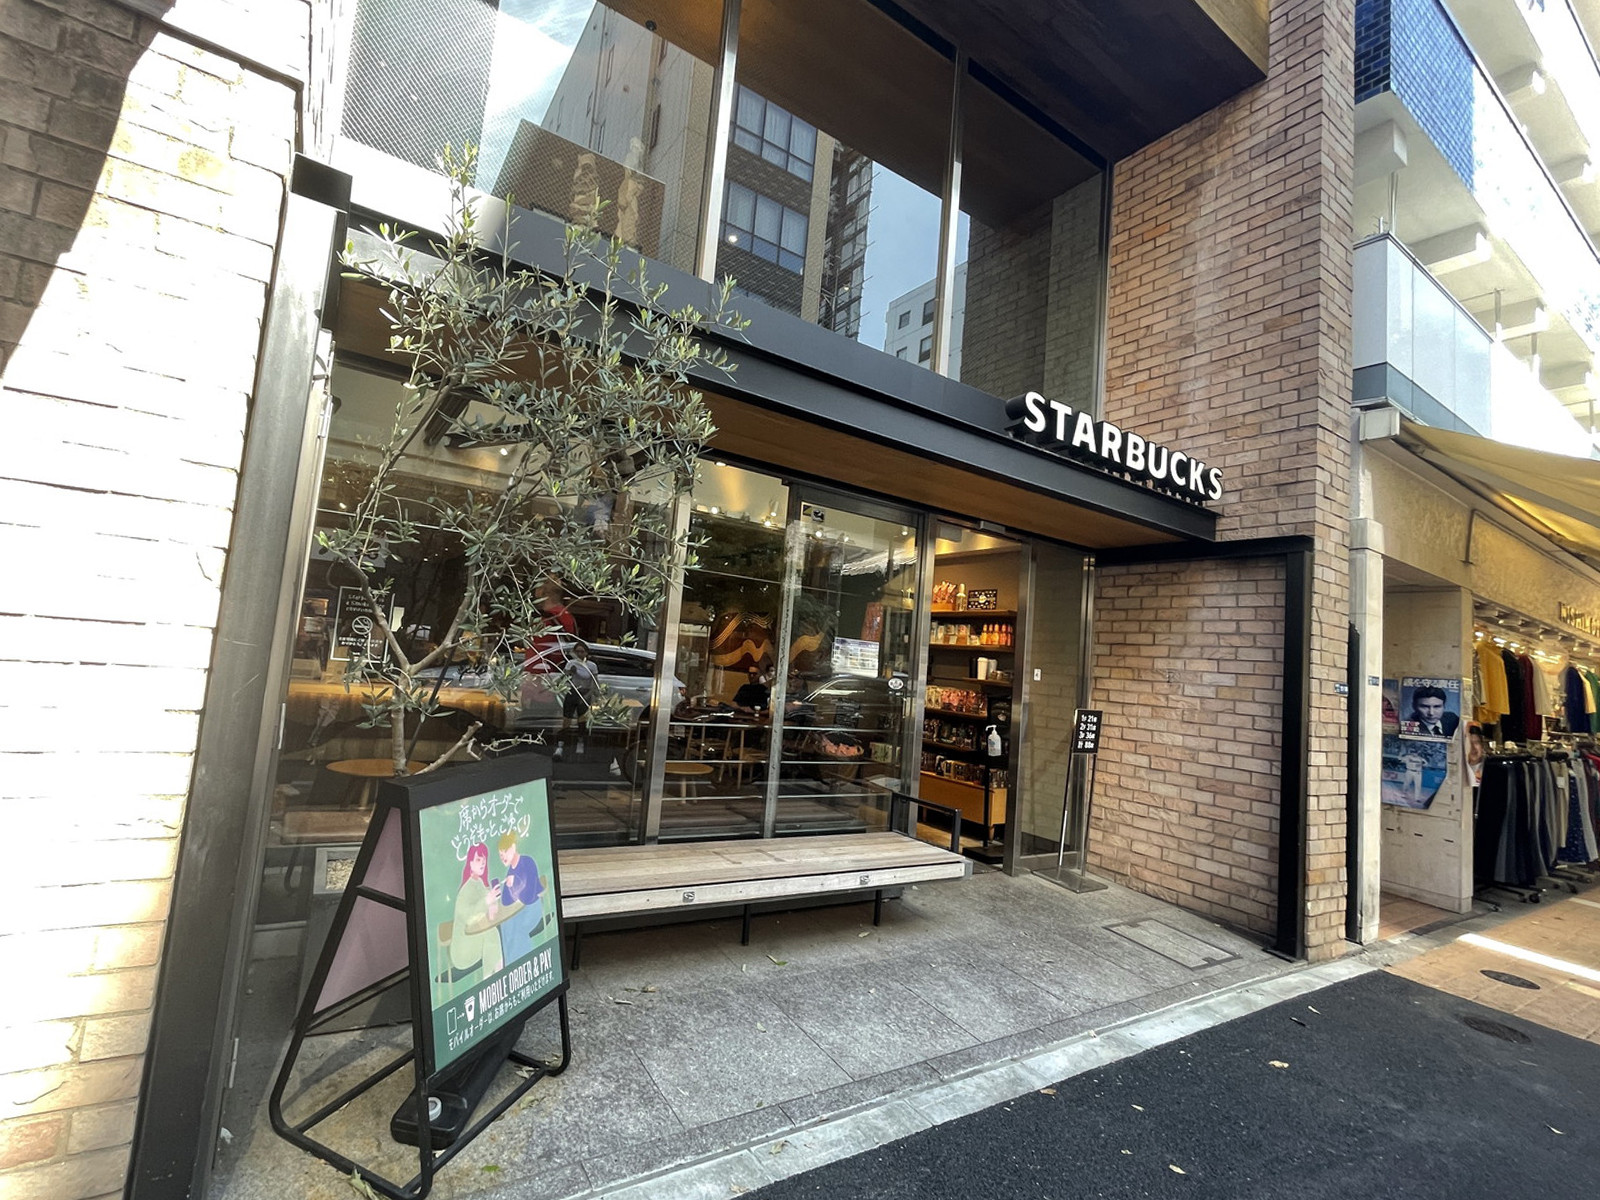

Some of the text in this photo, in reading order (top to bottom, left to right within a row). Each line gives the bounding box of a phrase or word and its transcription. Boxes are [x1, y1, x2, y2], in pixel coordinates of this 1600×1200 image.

[1023, 391, 1224, 500] STARBUCKS
[458, 792, 524, 833] 席からオーダーで
[479, 948, 553, 1014] MOBILE ORDER & PAY
